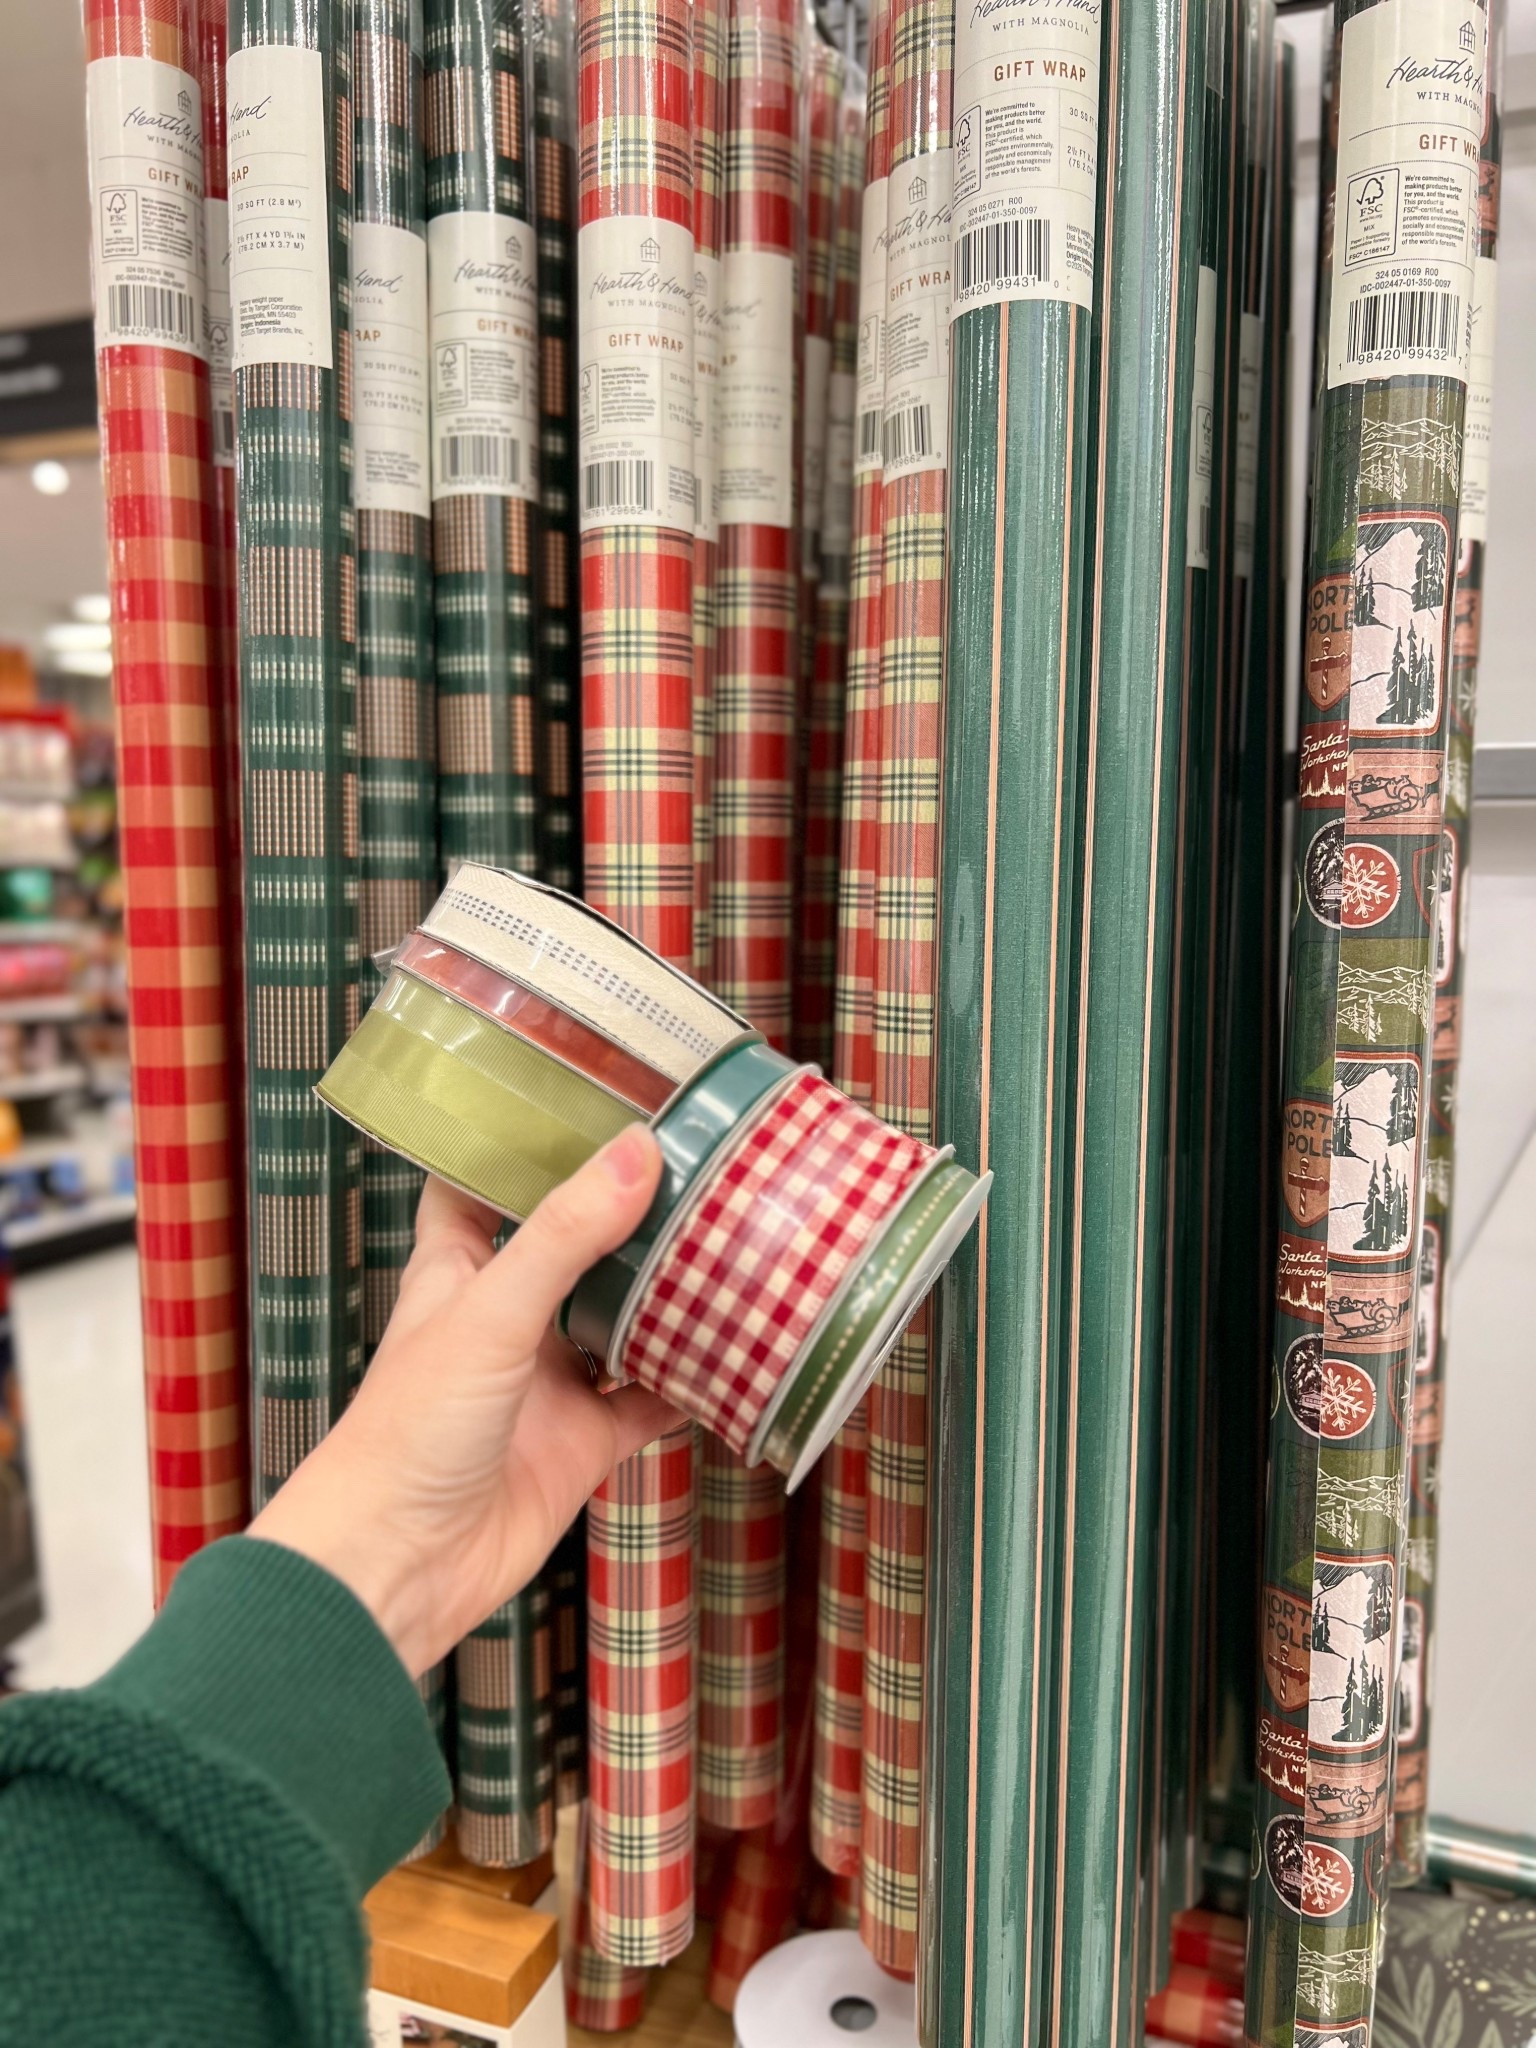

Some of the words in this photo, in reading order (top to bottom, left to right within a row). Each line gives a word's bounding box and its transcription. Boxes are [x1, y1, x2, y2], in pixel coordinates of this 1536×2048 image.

[992, 18, 1025, 32] WITH
[1032, 17, 1089, 35] MAGNOLIA
[994, 60, 1035, 81] GIFT
[1043, 60, 1086, 82] WRAP
[1386, 56, 1462, 88] Hearth
[1464, 65, 1473, 88] &
[1417, 91, 1450, 101] WITH
[985, 108, 1000, 116] We're
[1000, 101, 1028, 112] committed
[1069, 107, 1079, 116] 30
[1081, 111, 1088, 121] SQ
[123, 107, 183, 135] Hearth
[985, 115, 1003, 124] making
[1004, 110, 1028, 119] products
[147, 135, 173, 147] WITH
[985, 132, 996, 140] This
[997, 128, 1018, 137] product
[958, 142, 970, 159] FSC
[985, 145, 1009, 156] promotes
[1419, 134, 1458, 152] GIFT
[985, 154, 1004, 164] socially
[1005, 151, 1016, 159] and
[1017, 149, 1052, 157] economically
[1080, 149, 1086, 158] FT
[985, 160, 1015, 172] responsible
[1001, 167, 1020, 175] world's
[1069, 157, 1086, 171] (76.2
[148, 167, 180, 186] GIFT
[1449, 185, 1462, 193] better
[268, 198, 284, 207] (2.8
[968, 207, 977, 217] 324
[979, 203, 986, 213] 05
[988, 199, 1004, 210] 0271
[1008, 197, 1023, 205] R00
[1360, 204, 1383, 217] FSC
[1446, 208, 1459, 216] which
[916, 210, 927, 232] &
[1364, 224, 1375, 232] MIX
[1403, 222, 1424, 230] socially
[1437, 224, 1464, 235] economically
[246, 232, 253, 240] FT
[297, 232, 305, 240] IN
[1436, 233, 1463, 241] management
[239, 243, 254, 254] (76.2
[294, 242, 304, 251] M)
[454, 259, 515, 283] Hearth
[1375, 269, 1389, 280] 324
[1391, 269, 1401, 278] 05
[1403, 267, 1422, 276] 0169
[1425, 268, 1439, 276] R00
[590, 268, 651, 300] Hearth
[890, 278, 912, 302] GIFT
[959, 283, 990, 303] 98420
[996, 277, 1035, 290] 99431
[608, 299, 635, 307] WITH
[255, 319, 281, 327] Indonesia
[477, 318, 508, 333] GIFT
[256, 327, 271, 335] Target
[608, 334, 641, 348] GIFT
[648, 334, 684, 353] WRAP
[1338, 363, 1342, 371] 1
[1358, 349, 1400, 365] 98420
[1408, 349, 1447, 361] 99432
[1458, 356, 1462, 365] 7
[1307, 585, 1355, 615] ORT
[1302, 724, 1349, 757] Santa'
[1287, 1134, 1332, 1158] POLE
[1280, 1243, 1328, 1263] Santa'
[1267, 1617, 1312, 1650] POLE
[1260, 1718, 1308, 1750] Santa'
